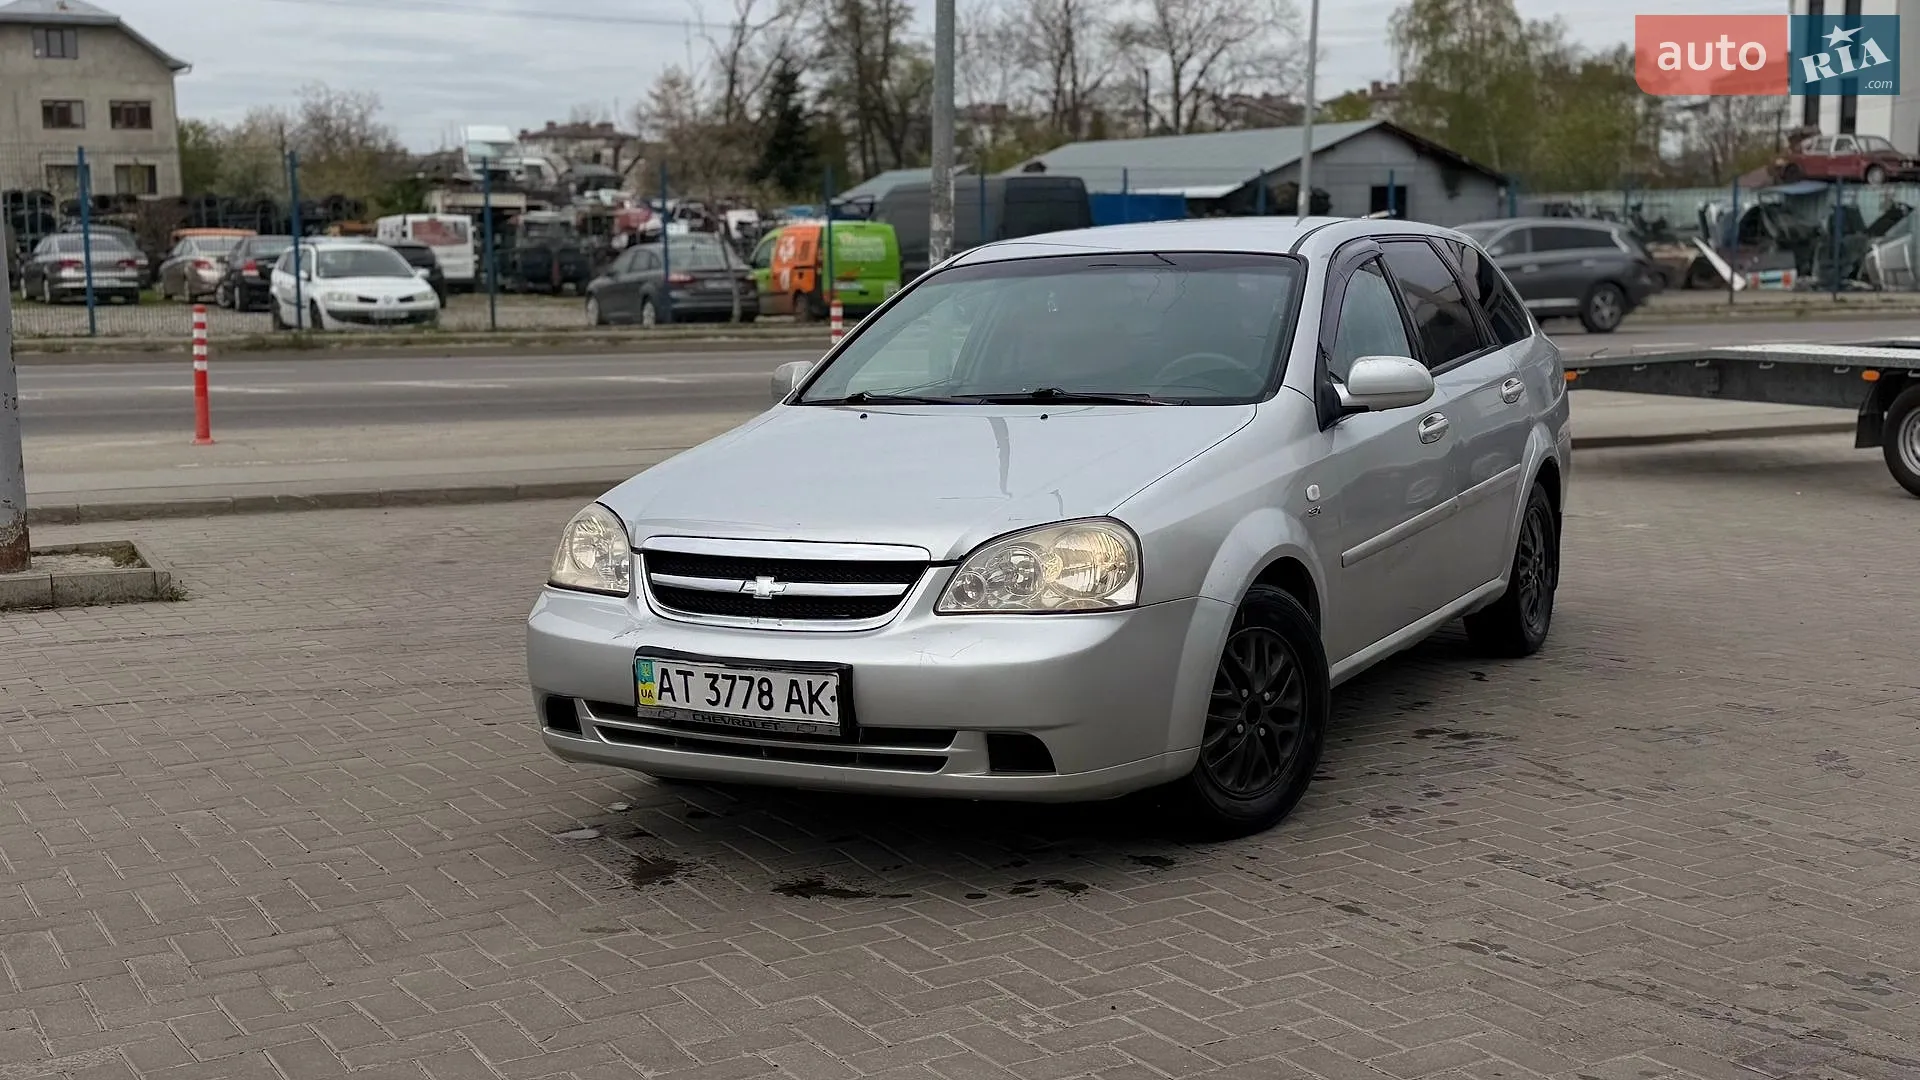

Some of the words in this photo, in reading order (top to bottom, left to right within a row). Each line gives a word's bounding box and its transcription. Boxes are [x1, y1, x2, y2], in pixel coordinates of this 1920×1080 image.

[640, 688, 654, 699] UA
[657, 667, 695, 704] AT
[704, 672, 774, 712] 3778
[784, 679, 831, 717] AK
[692, 713, 781, 731] CHEVROLET
